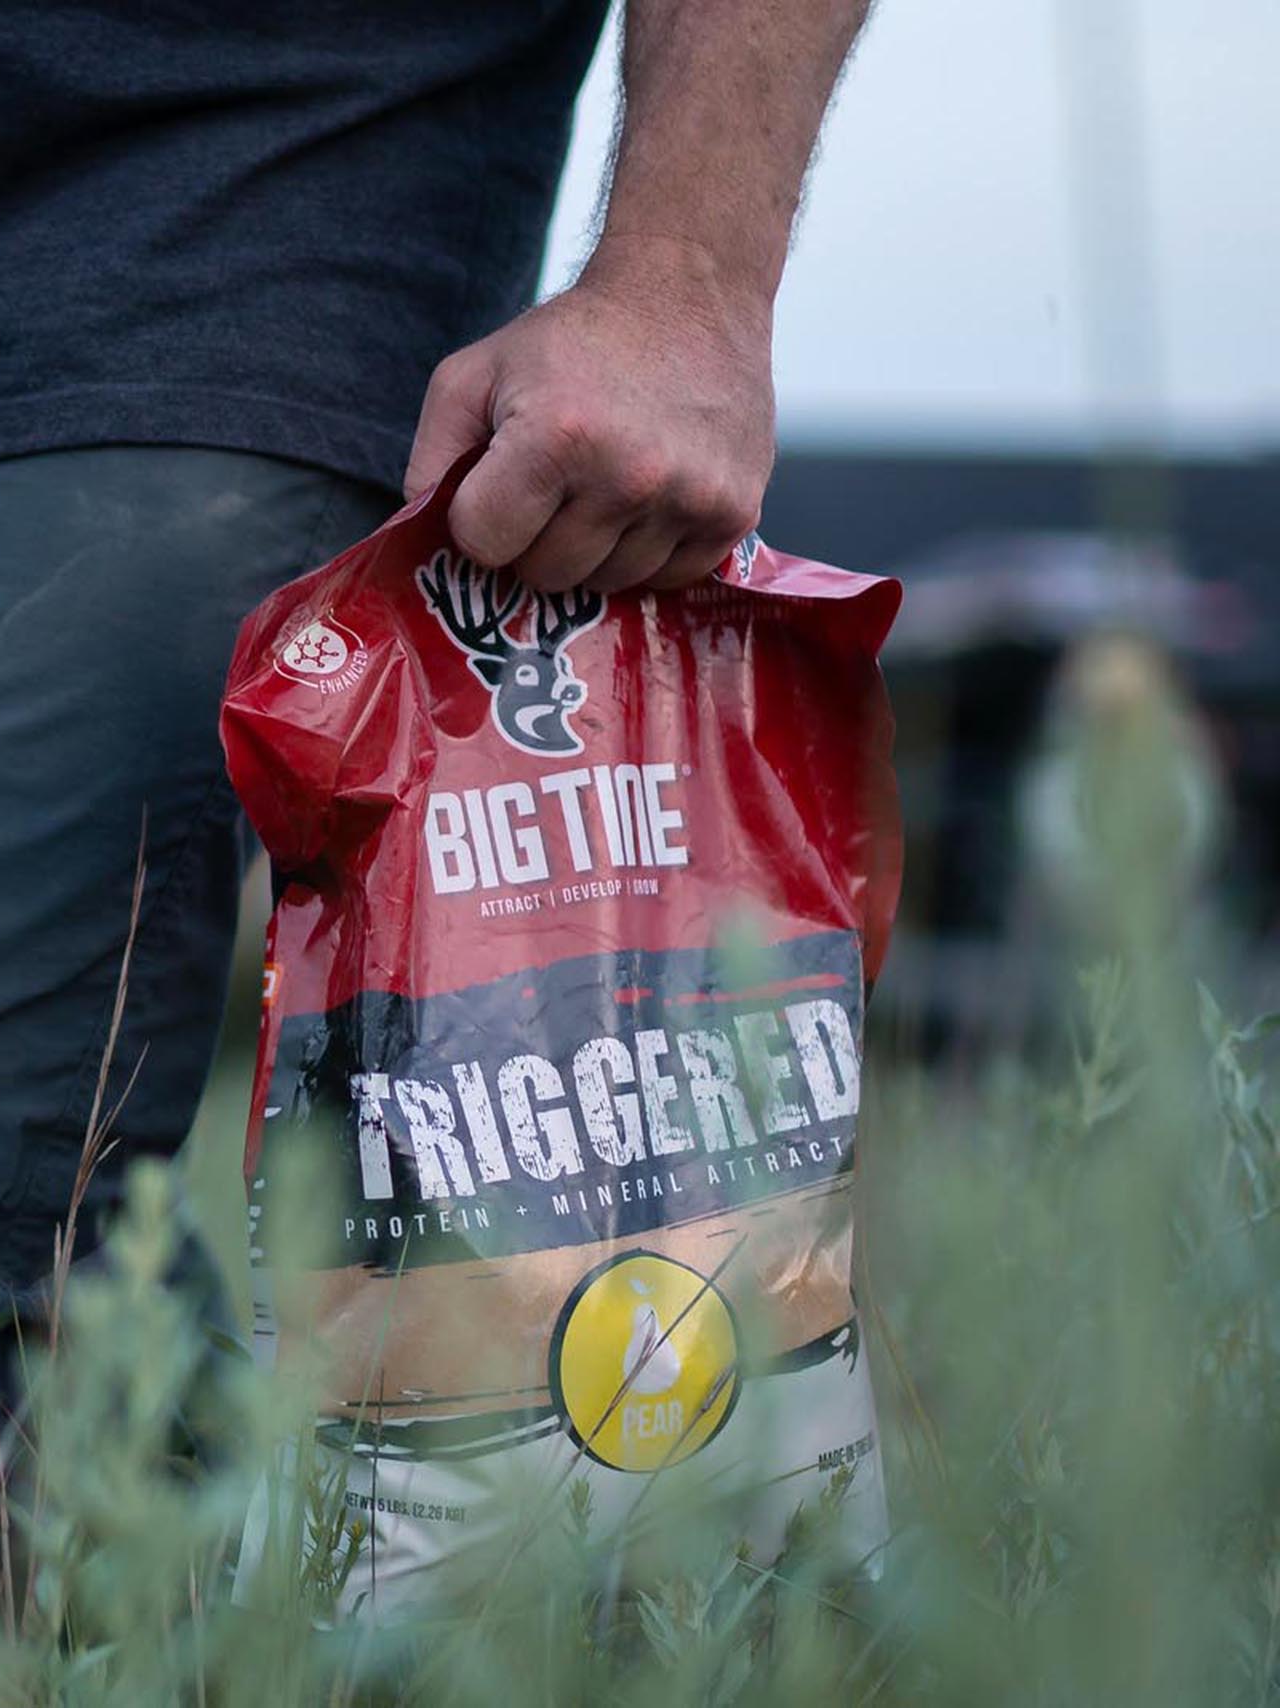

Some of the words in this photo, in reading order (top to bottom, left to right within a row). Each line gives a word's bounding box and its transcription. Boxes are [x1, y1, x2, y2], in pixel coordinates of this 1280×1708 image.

[318, 649, 369, 694] ENHANCED
[424, 781, 554, 894] BIG
[540, 762, 688, 873] TINE
[479, 892, 542, 918] ATTRACT
[561, 878, 623, 904] DEVELOP
[632, 878, 660, 896] GROW
[349, 997, 861, 1201] TRIGGERED
[344, 1206, 491, 1240] PROTEIN
[551, 1173, 683, 1216] MINERAL
[706, 1135, 850, 1186] ATTRACT
[622, 1400, 684, 1440] PEAR
[377, 1498, 385, 1512] 5
[387, 1500, 410, 1516] LBS.
